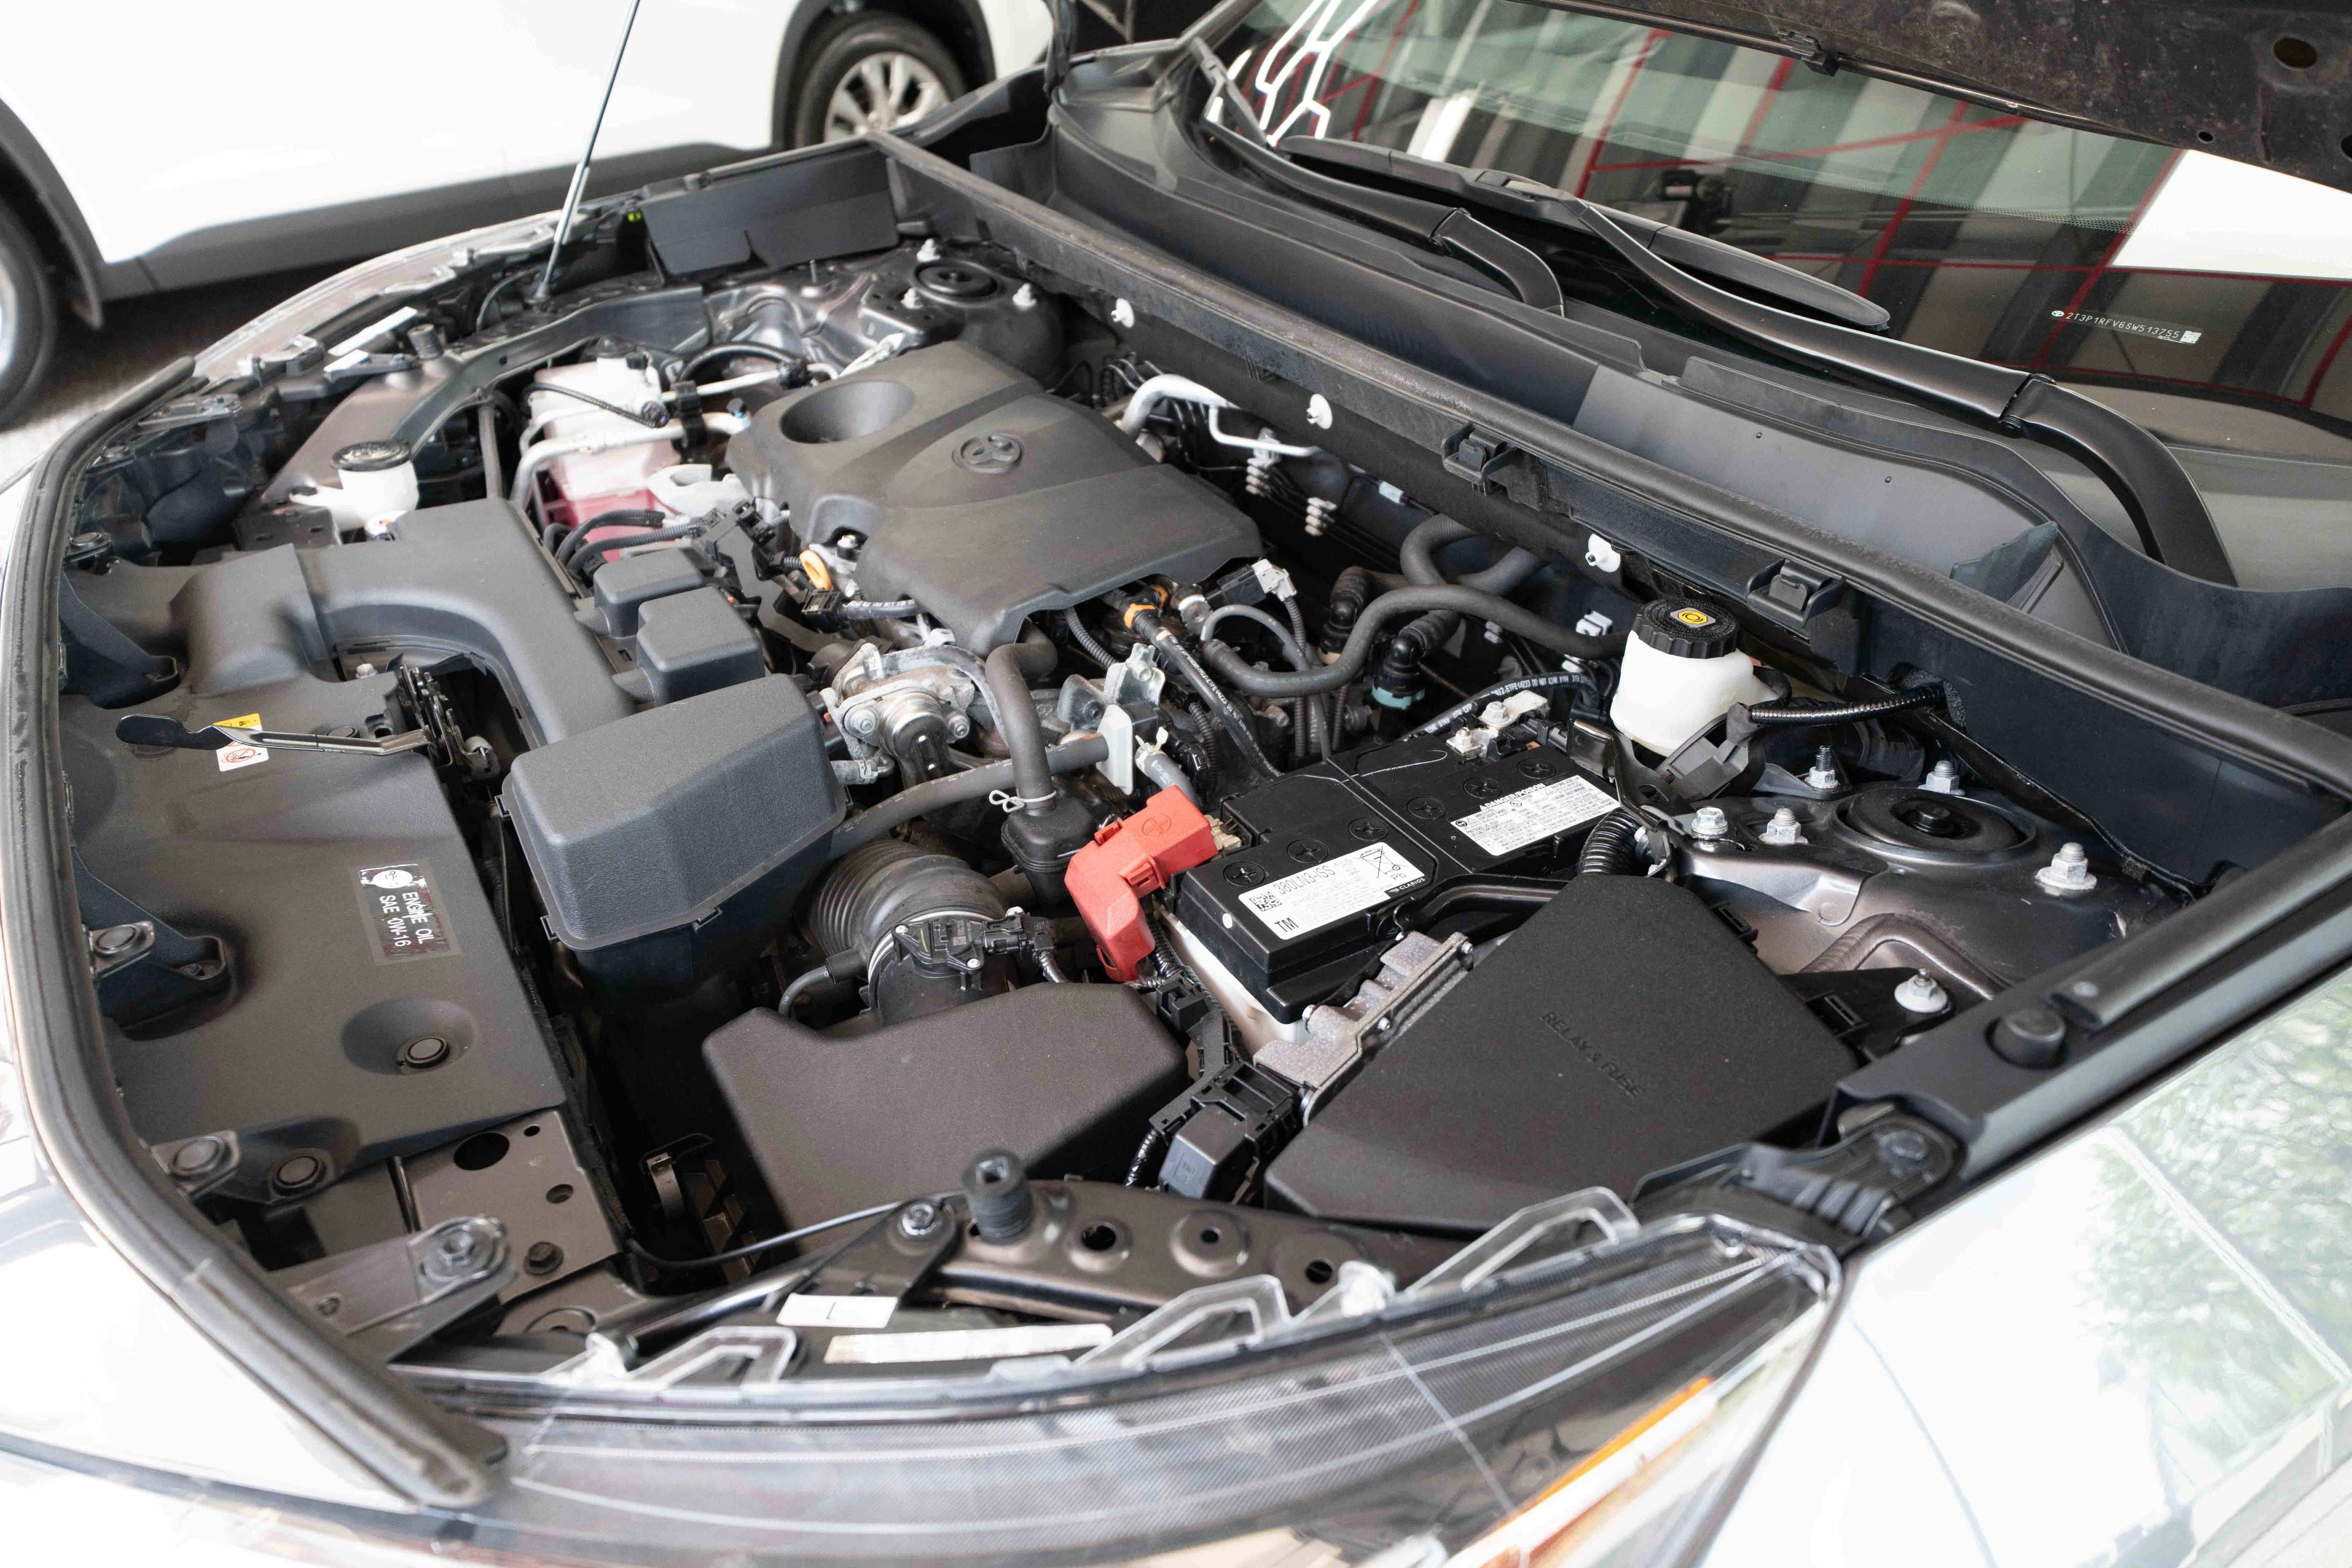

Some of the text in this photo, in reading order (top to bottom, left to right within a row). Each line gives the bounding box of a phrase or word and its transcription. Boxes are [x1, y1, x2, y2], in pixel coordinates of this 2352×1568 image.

[2066, 312, 2180, 338] 2T3P1RFV6SW513755
[1484, 783, 1546, 808] DANGER/POISON
[1273, 866, 1335, 894] 380LN3-ISS
[1399, 878, 1425, 890] CLARIOS
[379, 895, 400, 913] SAE
[402, 892, 434, 944] ENGINE OIL
[1274, 918, 1298, 932] TM
